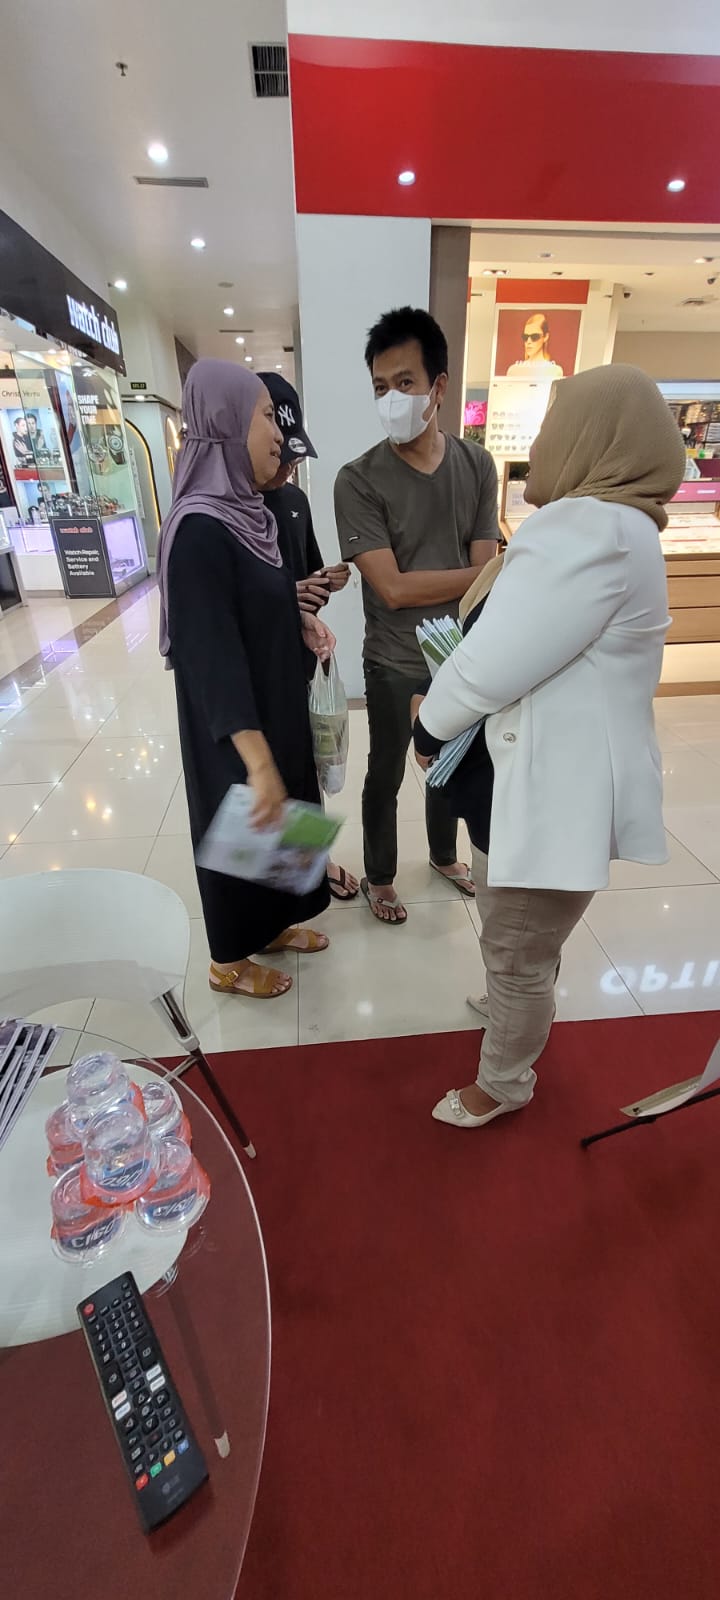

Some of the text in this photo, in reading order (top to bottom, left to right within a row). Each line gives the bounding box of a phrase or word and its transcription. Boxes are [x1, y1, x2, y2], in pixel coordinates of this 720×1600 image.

[66, 294, 120, 356] watch club
[77, 394, 99, 404] SHAPE
[79, 405, 97, 414] YOUR
[277, 403, 296, 427] NY
[59, 526, 93, 534] watch club
